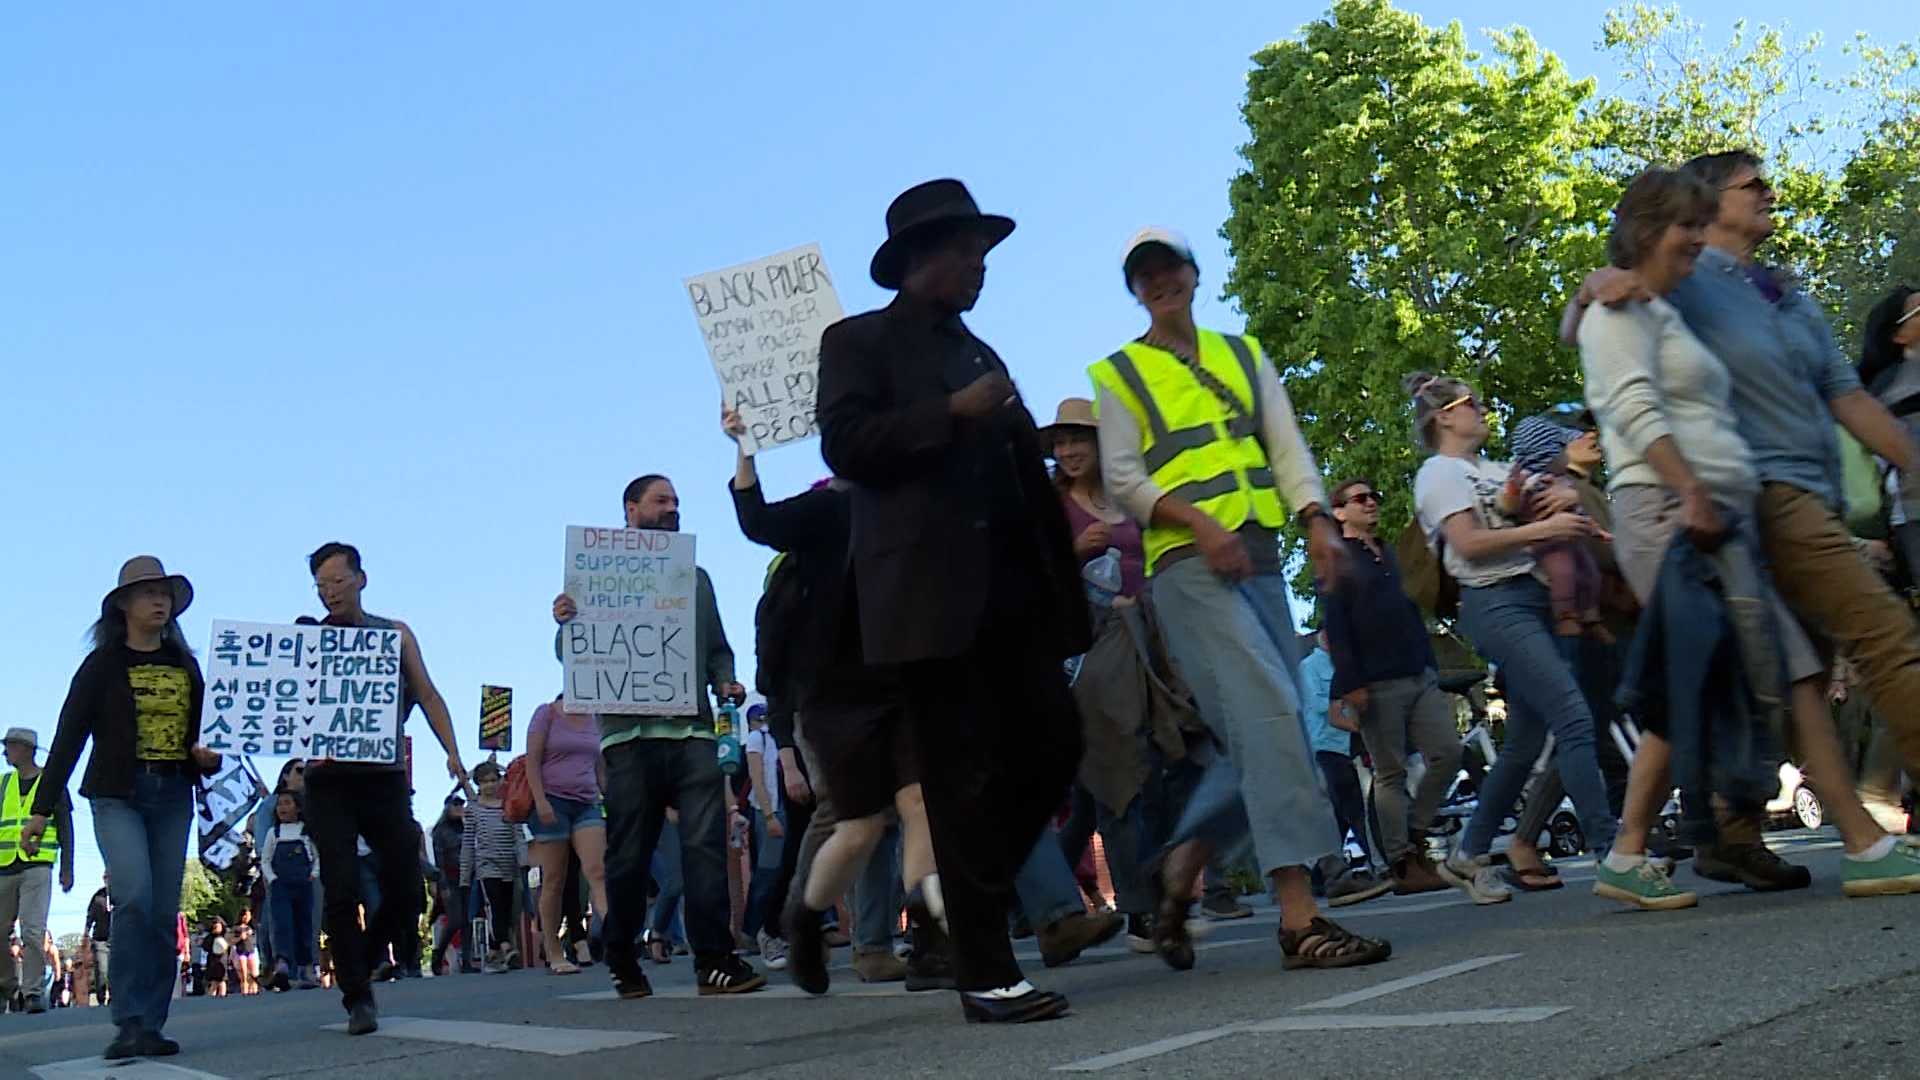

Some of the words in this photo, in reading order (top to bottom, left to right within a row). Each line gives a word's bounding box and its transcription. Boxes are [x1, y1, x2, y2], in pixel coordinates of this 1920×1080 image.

[689, 271, 768, 317] BLACK
[766, 253, 832, 299] POWER
[760, 298, 821, 329] POWER
[735, 381, 784, 413] ALL
[584, 528, 671, 552] DEFEND
[575, 553, 672, 575] SUPPORT
[588, 575, 657, 593] HONOR
[584, 594, 645, 609] UPLIFT
[215, 630, 304, 668] 흑인의
[319, 629, 398, 654] BLACK
[571, 623, 688, 673] BLACK
[211, 678, 300, 712] 생명은
[319, 679, 397, 704] LIVES
[573, 671, 689, 704] LIVES!
[203, 715, 299, 754] 소중함
[329, 707, 382, 733] ARE
[311, 733, 395, 760] PRECIOUS
